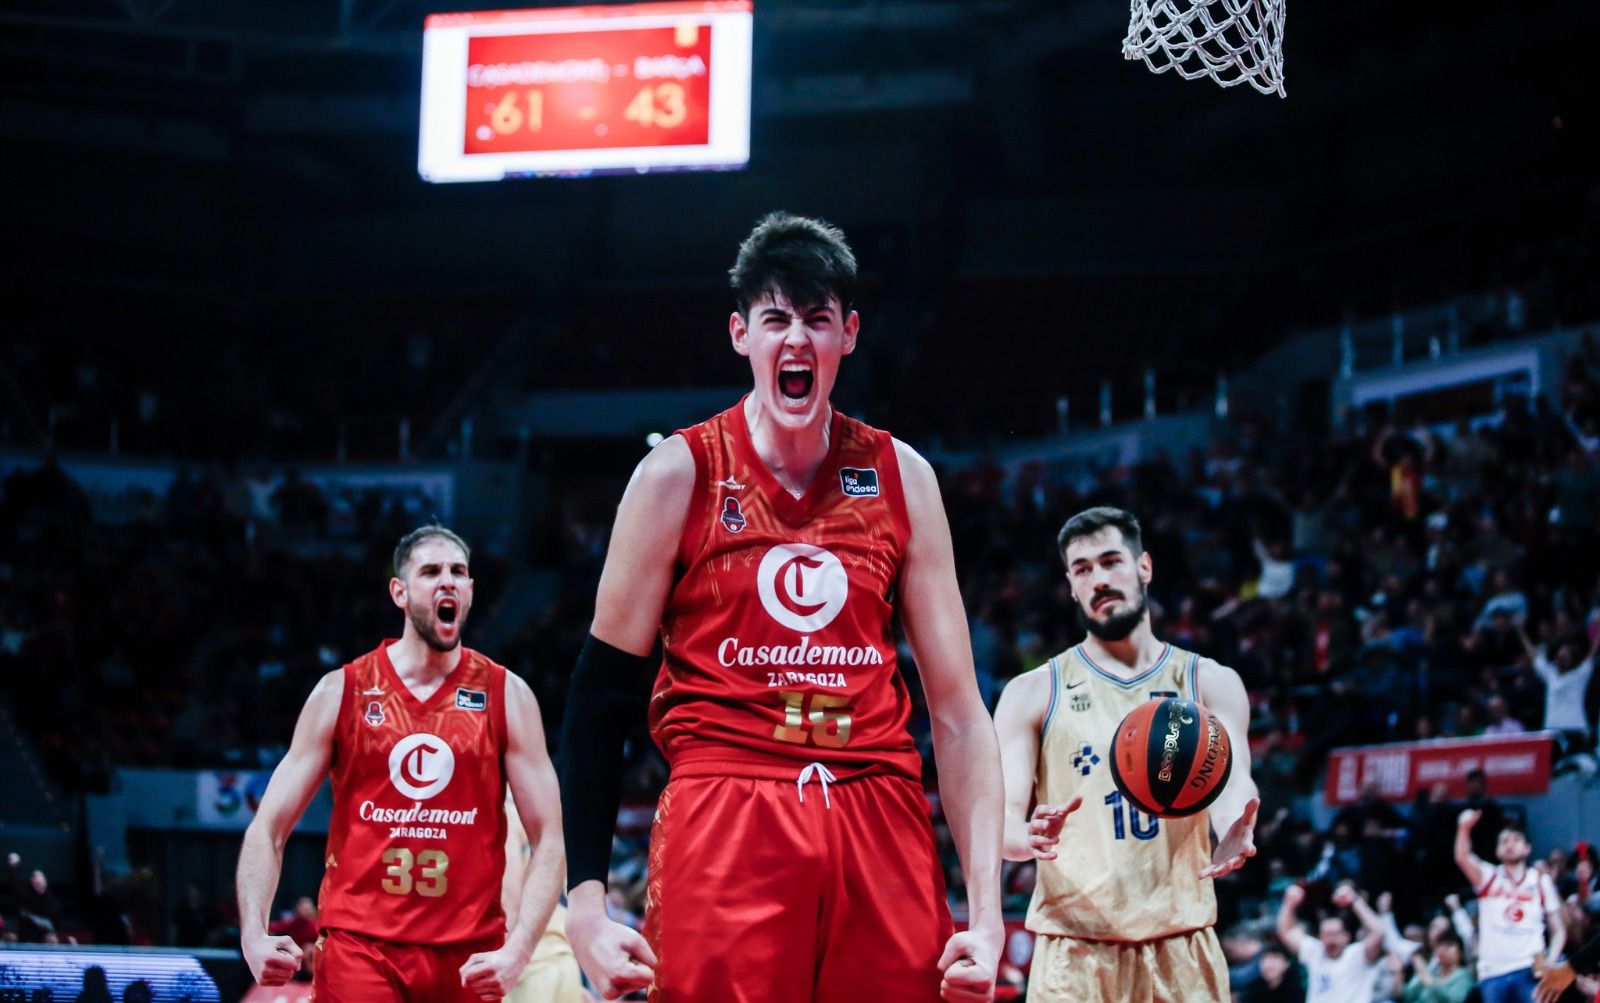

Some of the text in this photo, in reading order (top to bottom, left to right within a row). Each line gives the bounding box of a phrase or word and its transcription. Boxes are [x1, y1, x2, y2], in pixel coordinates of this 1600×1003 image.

[491, 90, 544, 135] 61
[624, 82, 687, 129] 43
[717, 636, 884, 667] Casademon
[773, 691, 852, 748] 15
[359, 800, 478, 825] Casademont
[1104, 790, 1160, 841] 10
[380, 847, 449, 898] 33
